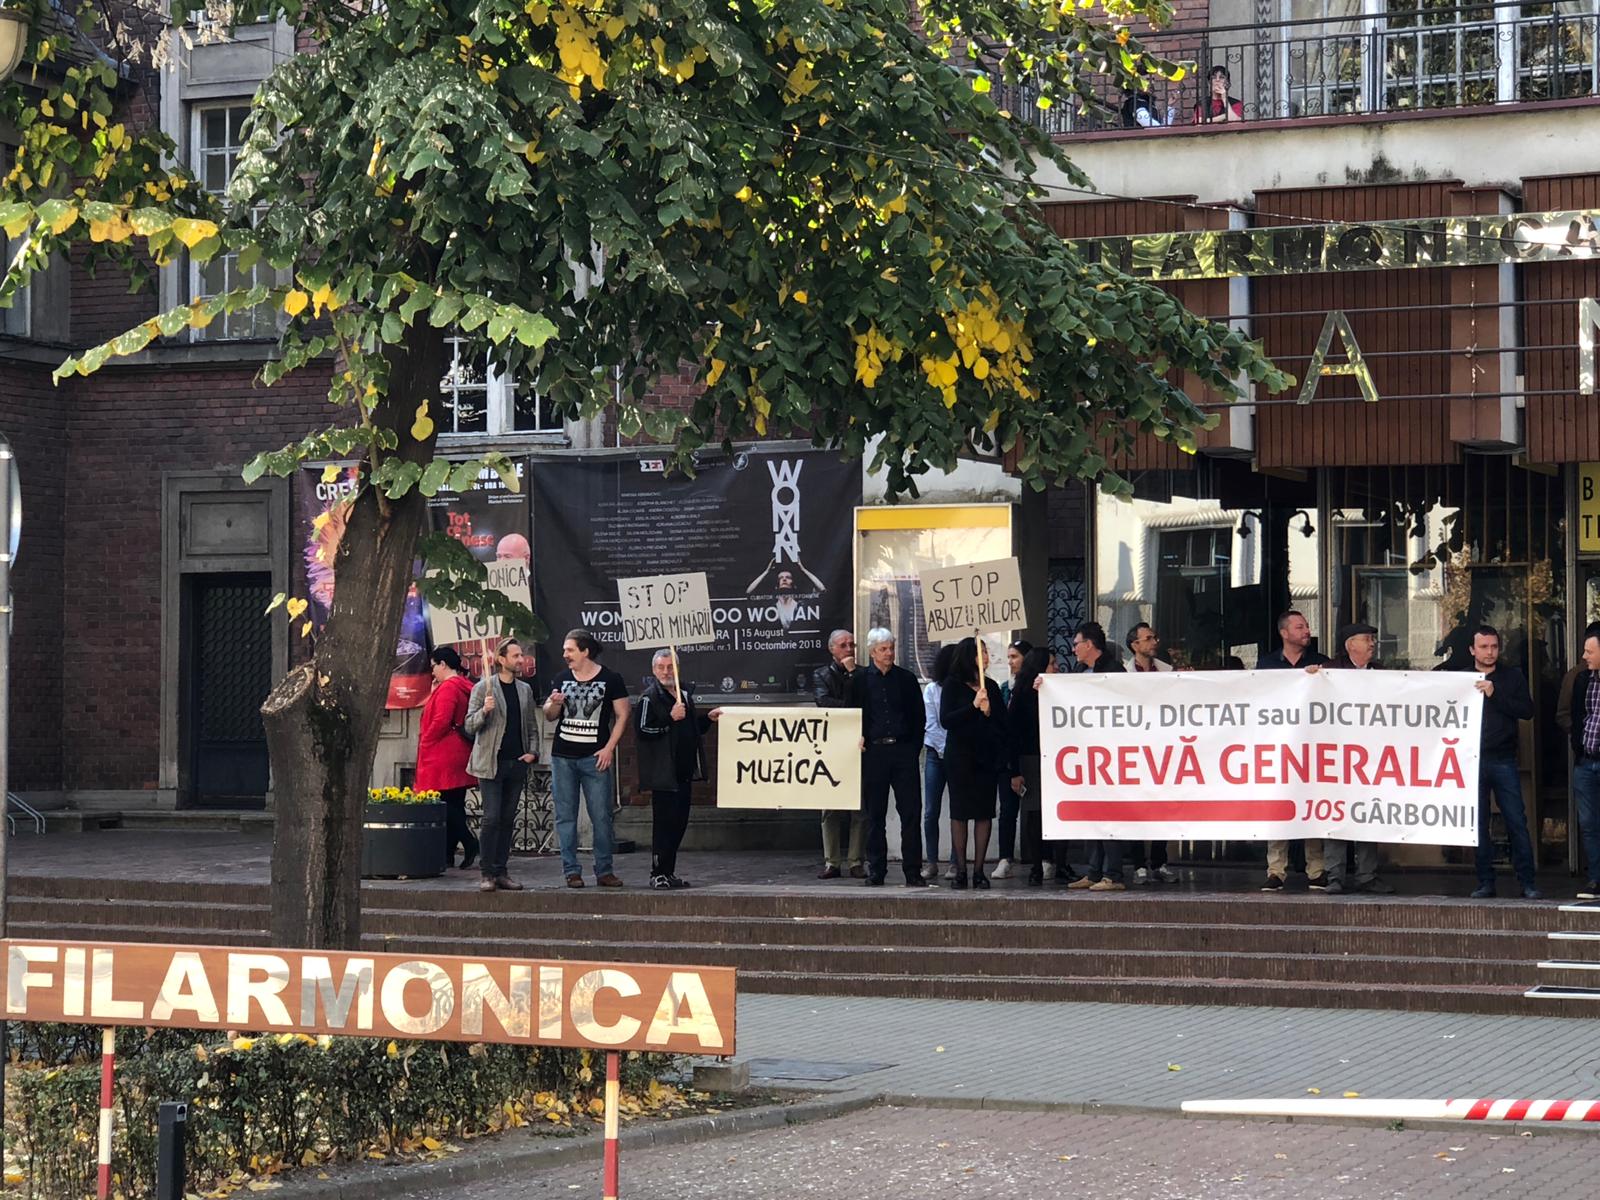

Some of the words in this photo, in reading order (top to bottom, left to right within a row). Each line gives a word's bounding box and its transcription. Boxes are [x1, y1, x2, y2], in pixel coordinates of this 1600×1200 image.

[1062, 214, 1600, 280] ILARMONICA
[766, 459, 804, 563] WOMAN
[1582, 515, 1600, 539] T
[932, 571, 999, 602] STOP
[747, 605, 820, 623] WOAN
[741, 629, 752, 637] 15
[754, 628, 784, 639] August
[741, 641, 752, 650] 15
[755, 640, 797, 650] Octombrie
[799, 639, 821, 649] 2018
[1052, 705, 1151, 730] DICTEU,
[1160, 703, 1250, 727] DICTAT
[1258, 707, 1300, 725] sau
[1309, 700, 1469, 728] DICTATURĂ!
[1055, 735, 1205, 786] GREVĂ
[1219, 737, 1466, 789] GENERALĂ
[1302, 799, 1345, 822] JOS
[6, 945, 723, 1048] FILARMONICA
